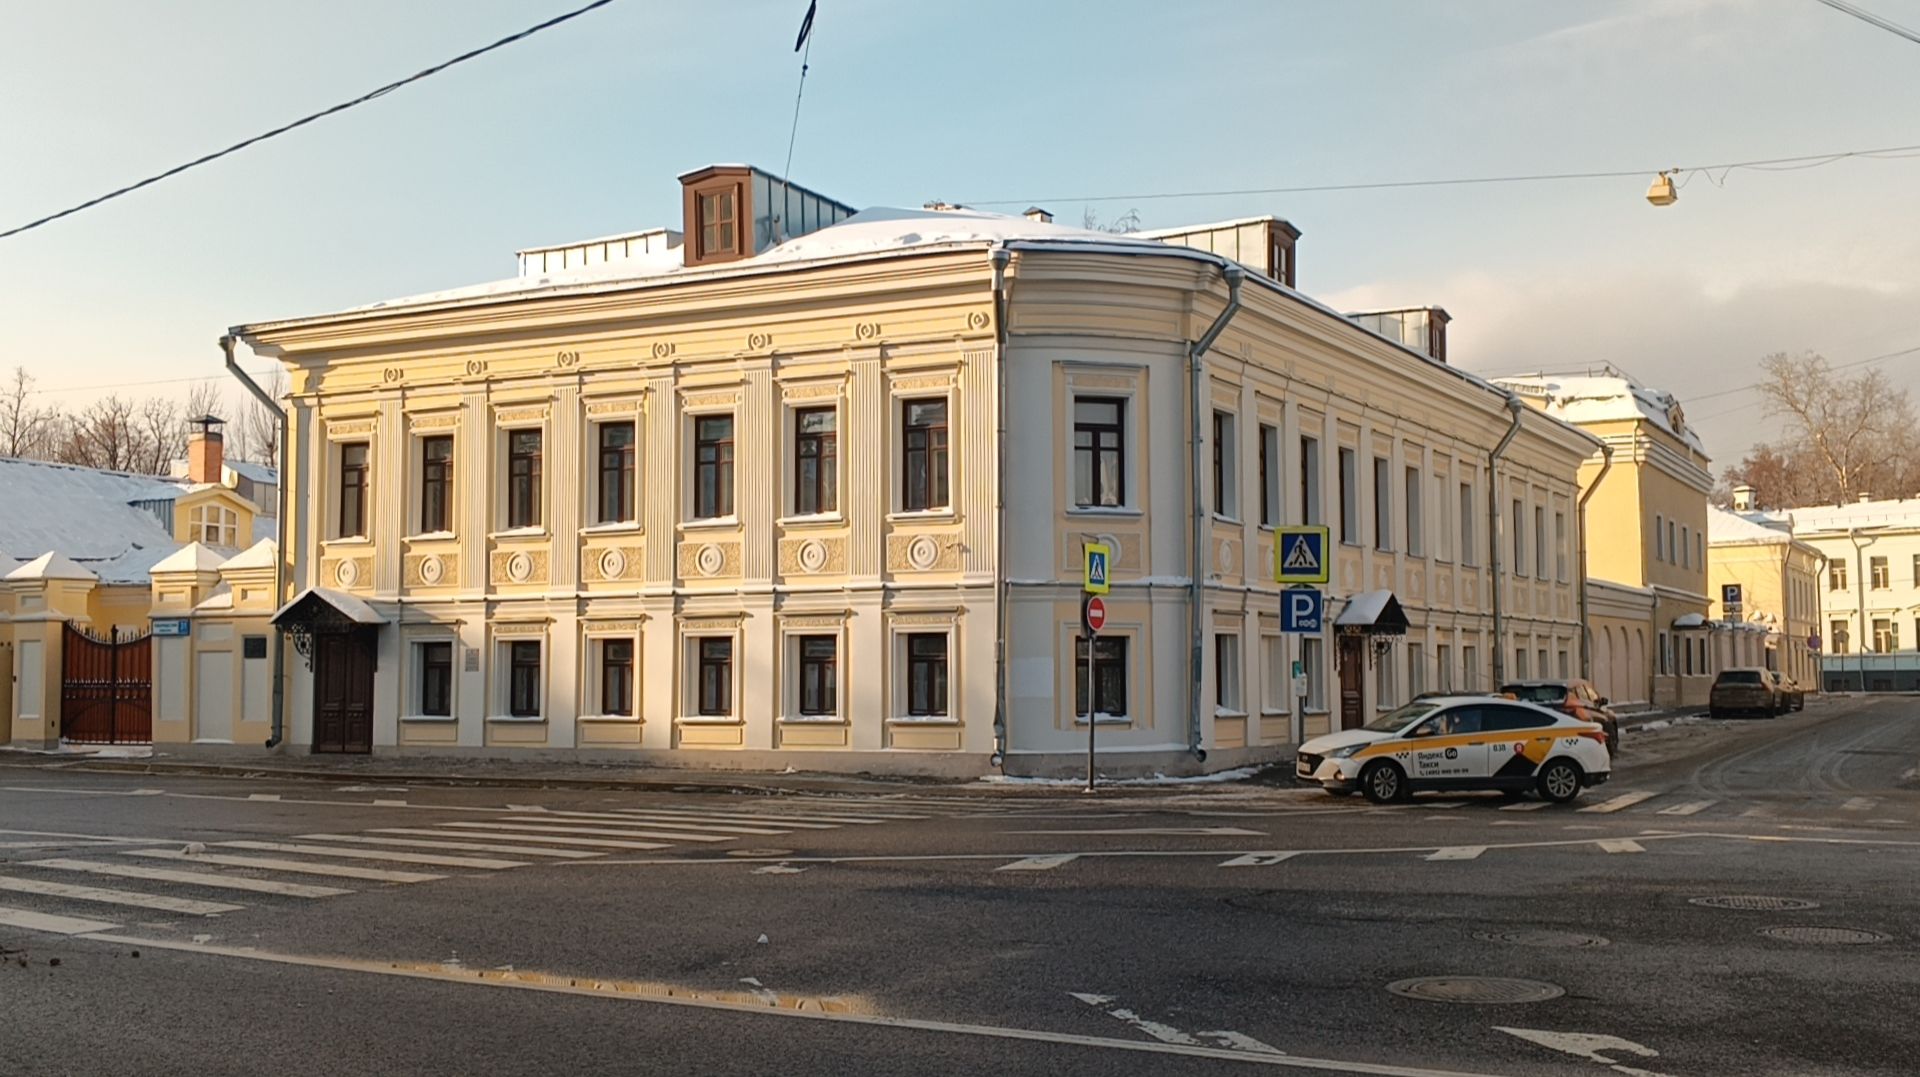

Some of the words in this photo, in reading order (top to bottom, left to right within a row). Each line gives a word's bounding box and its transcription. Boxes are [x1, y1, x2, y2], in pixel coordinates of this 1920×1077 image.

[1727, 586, 1738, 601] P
[1291, 594, 1314, 628] P
[1418, 752, 1444, 760] Яндекс
